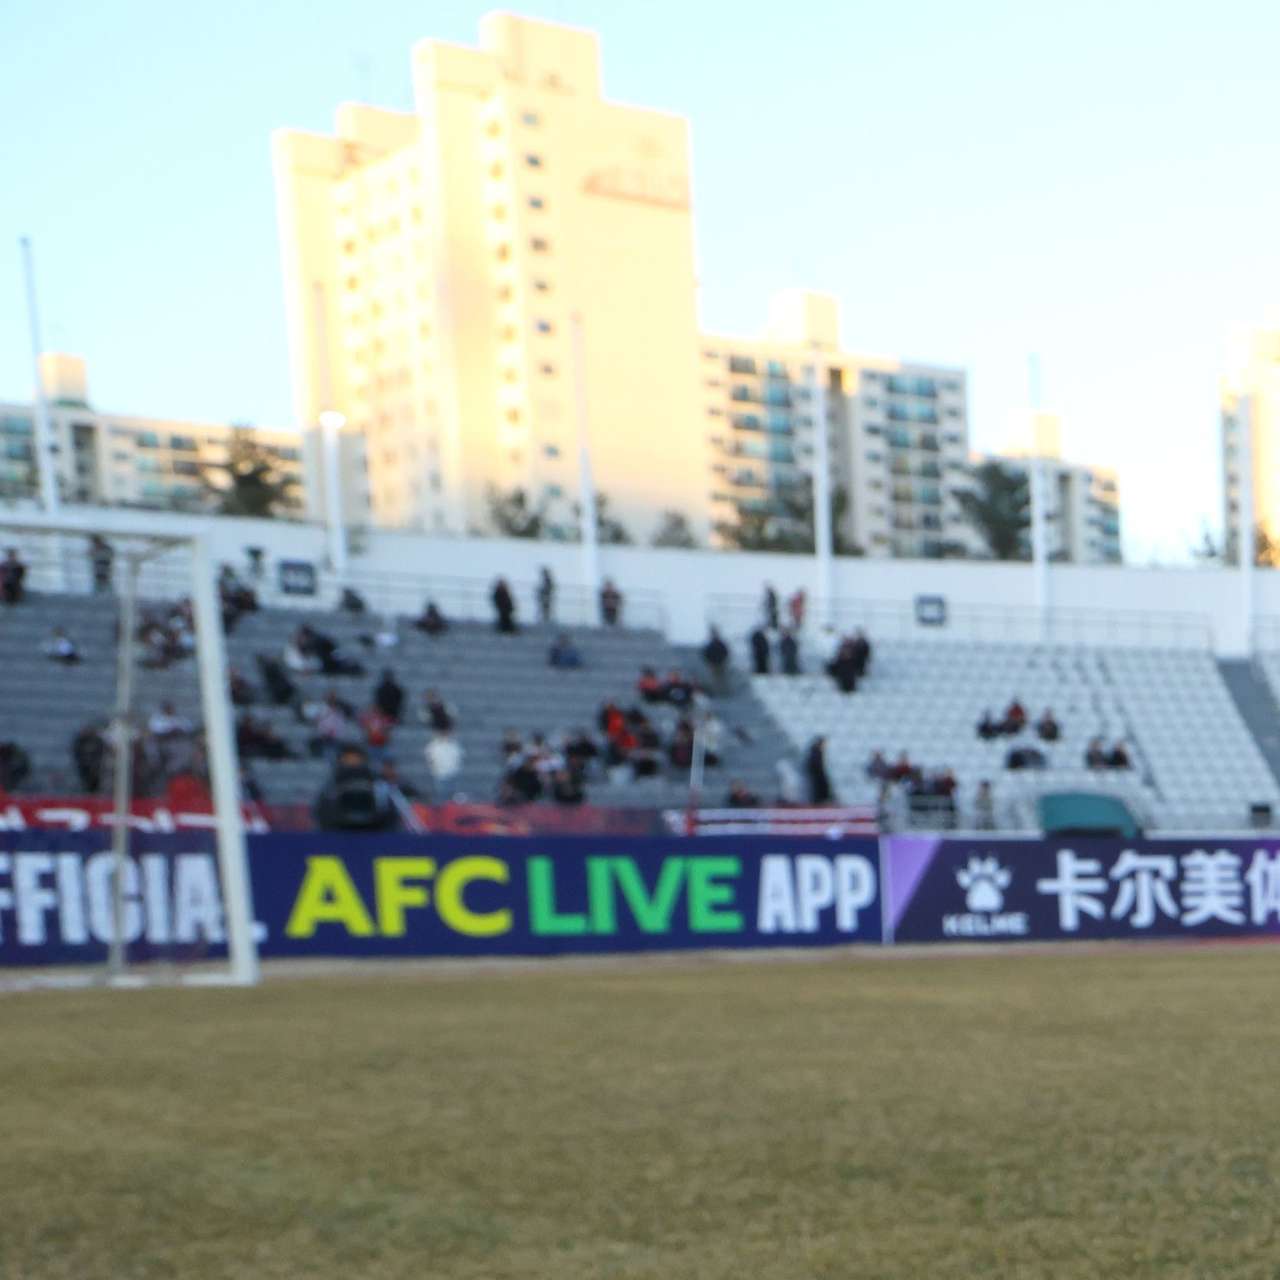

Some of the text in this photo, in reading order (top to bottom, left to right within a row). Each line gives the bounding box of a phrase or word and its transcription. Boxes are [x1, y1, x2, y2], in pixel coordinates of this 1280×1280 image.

[286, 855, 513, 938] AFC
[527, 855, 744, 936] LIVE
[757, 854, 877, 934] APP
